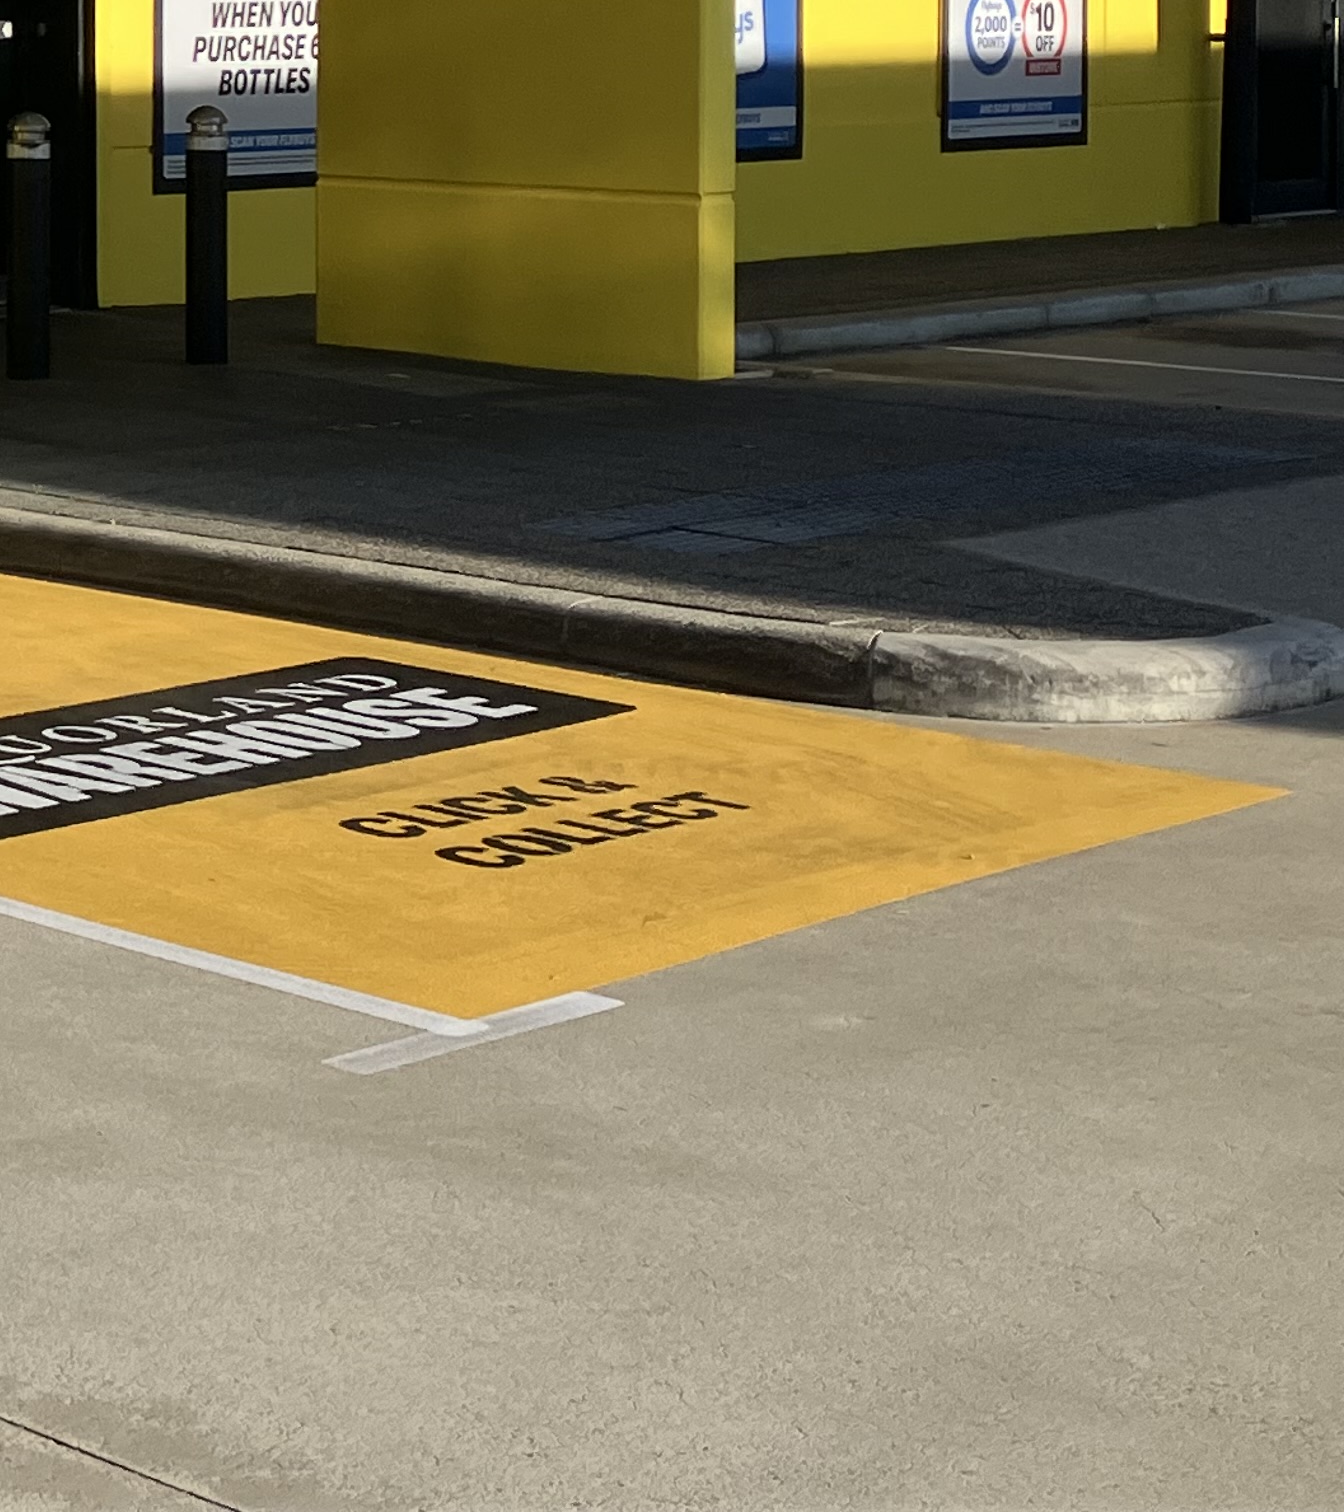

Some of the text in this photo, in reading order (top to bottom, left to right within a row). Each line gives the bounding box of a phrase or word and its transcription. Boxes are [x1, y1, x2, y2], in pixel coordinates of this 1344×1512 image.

[212, 0, 319, 28] WHEN YOU
[974, 15, 1008, 35] 2,000
[1030, 2, 1055, 32] $10
[192, 34, 307, 62] PURCHASE
[1035, 35, 1055, 52] OFF
[218, 67, 311, 96] BOTTLES
[338, 775, 640, 838] CLICK &
[434, 791, 752, 868] COLLECT
